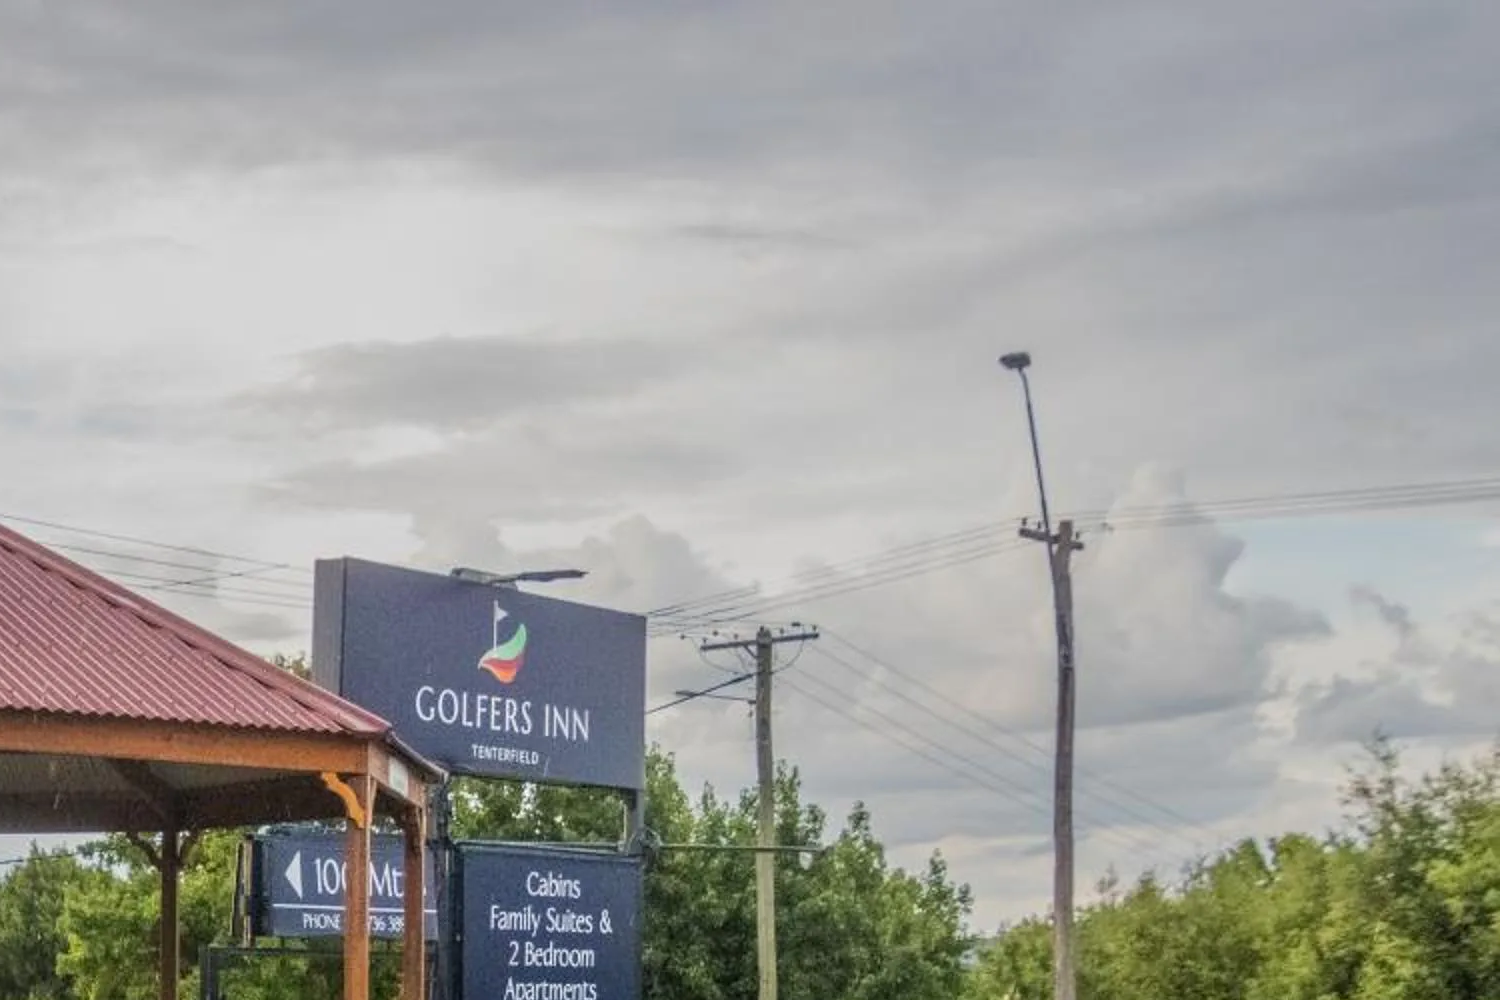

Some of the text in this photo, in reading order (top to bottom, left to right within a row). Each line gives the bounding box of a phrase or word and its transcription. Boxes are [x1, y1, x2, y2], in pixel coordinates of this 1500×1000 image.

[415, 686, 589, 741] GOLFERS INN
[472, 744, 539, 766] TENTERFIELD
[526, 871, 581, 899] Cabins
[490, 905, 613, 937] Family Suites &
[509, 941, 595, 967] 2 Bedroom
